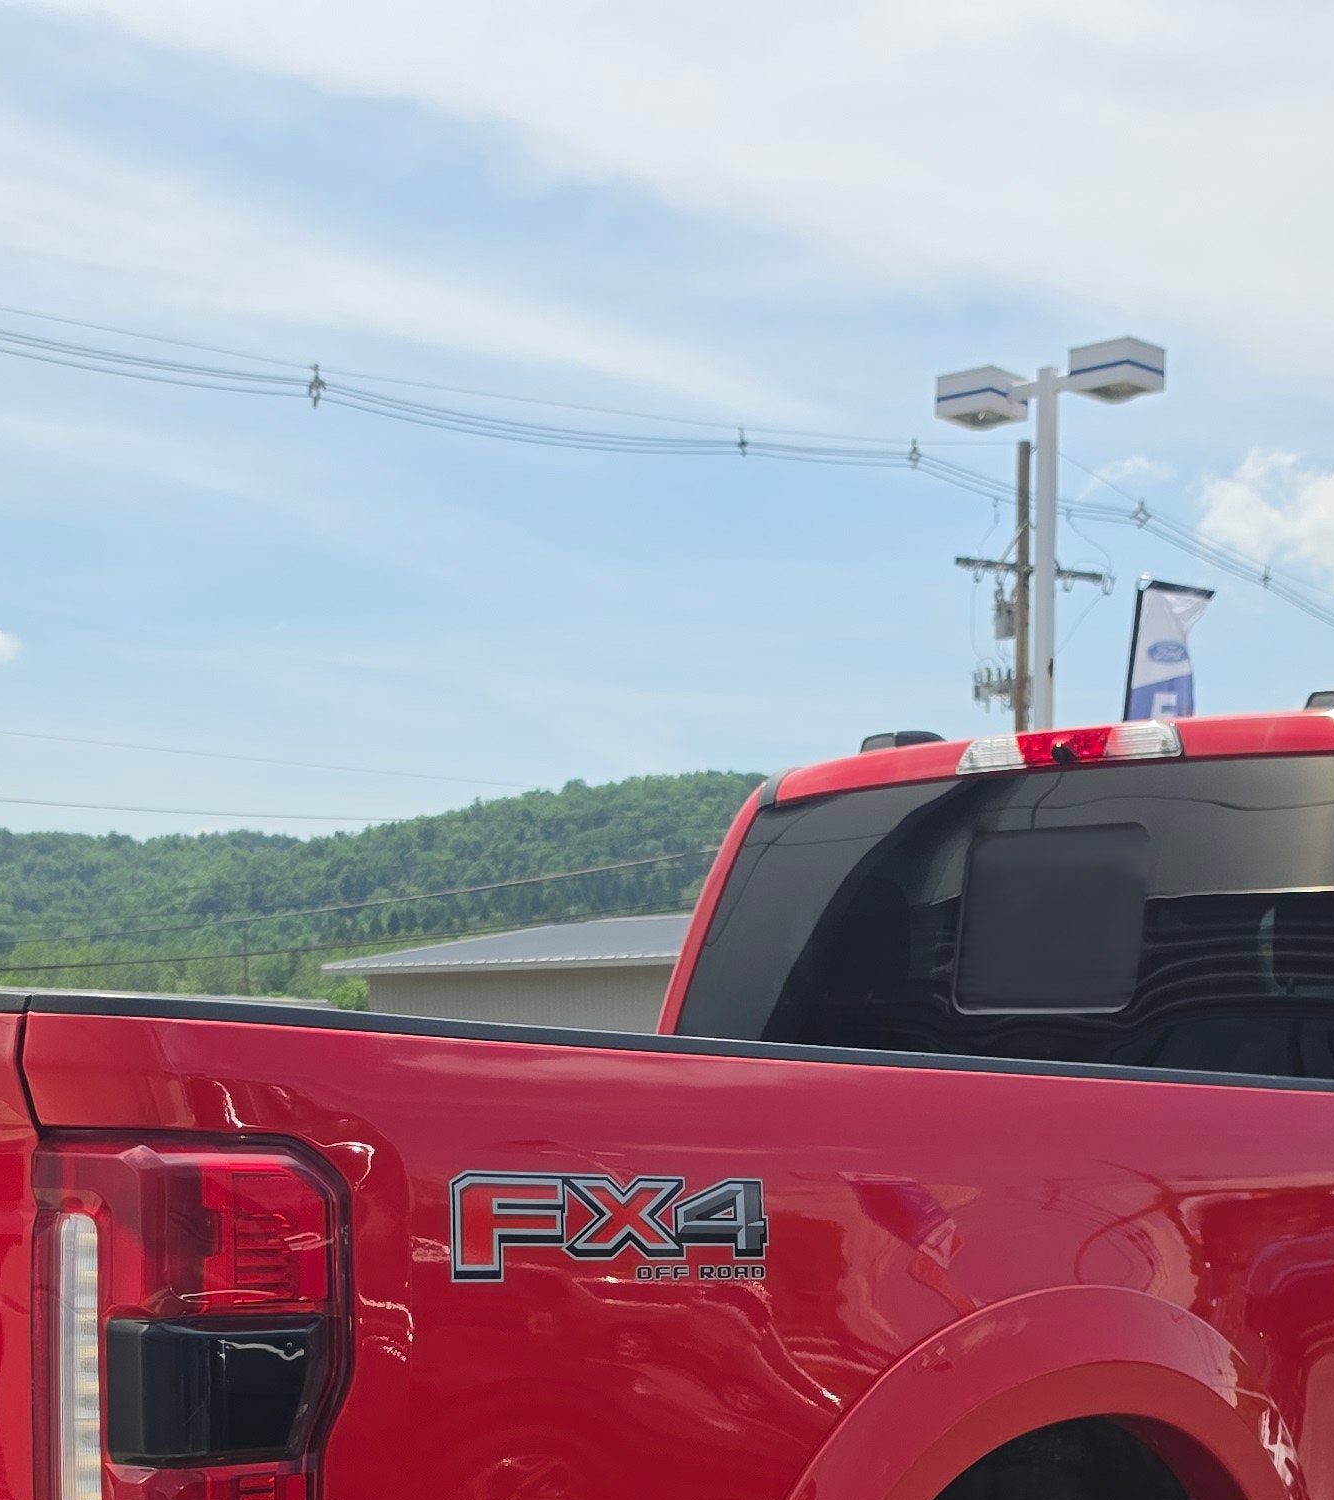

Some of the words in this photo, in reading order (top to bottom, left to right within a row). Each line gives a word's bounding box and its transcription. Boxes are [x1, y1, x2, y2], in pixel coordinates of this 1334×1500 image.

[449, 1169, 770, 1283] FX4
[635, 1264, 690, 1282] OFF
[698, 1264, 767, 1281] ROAD
